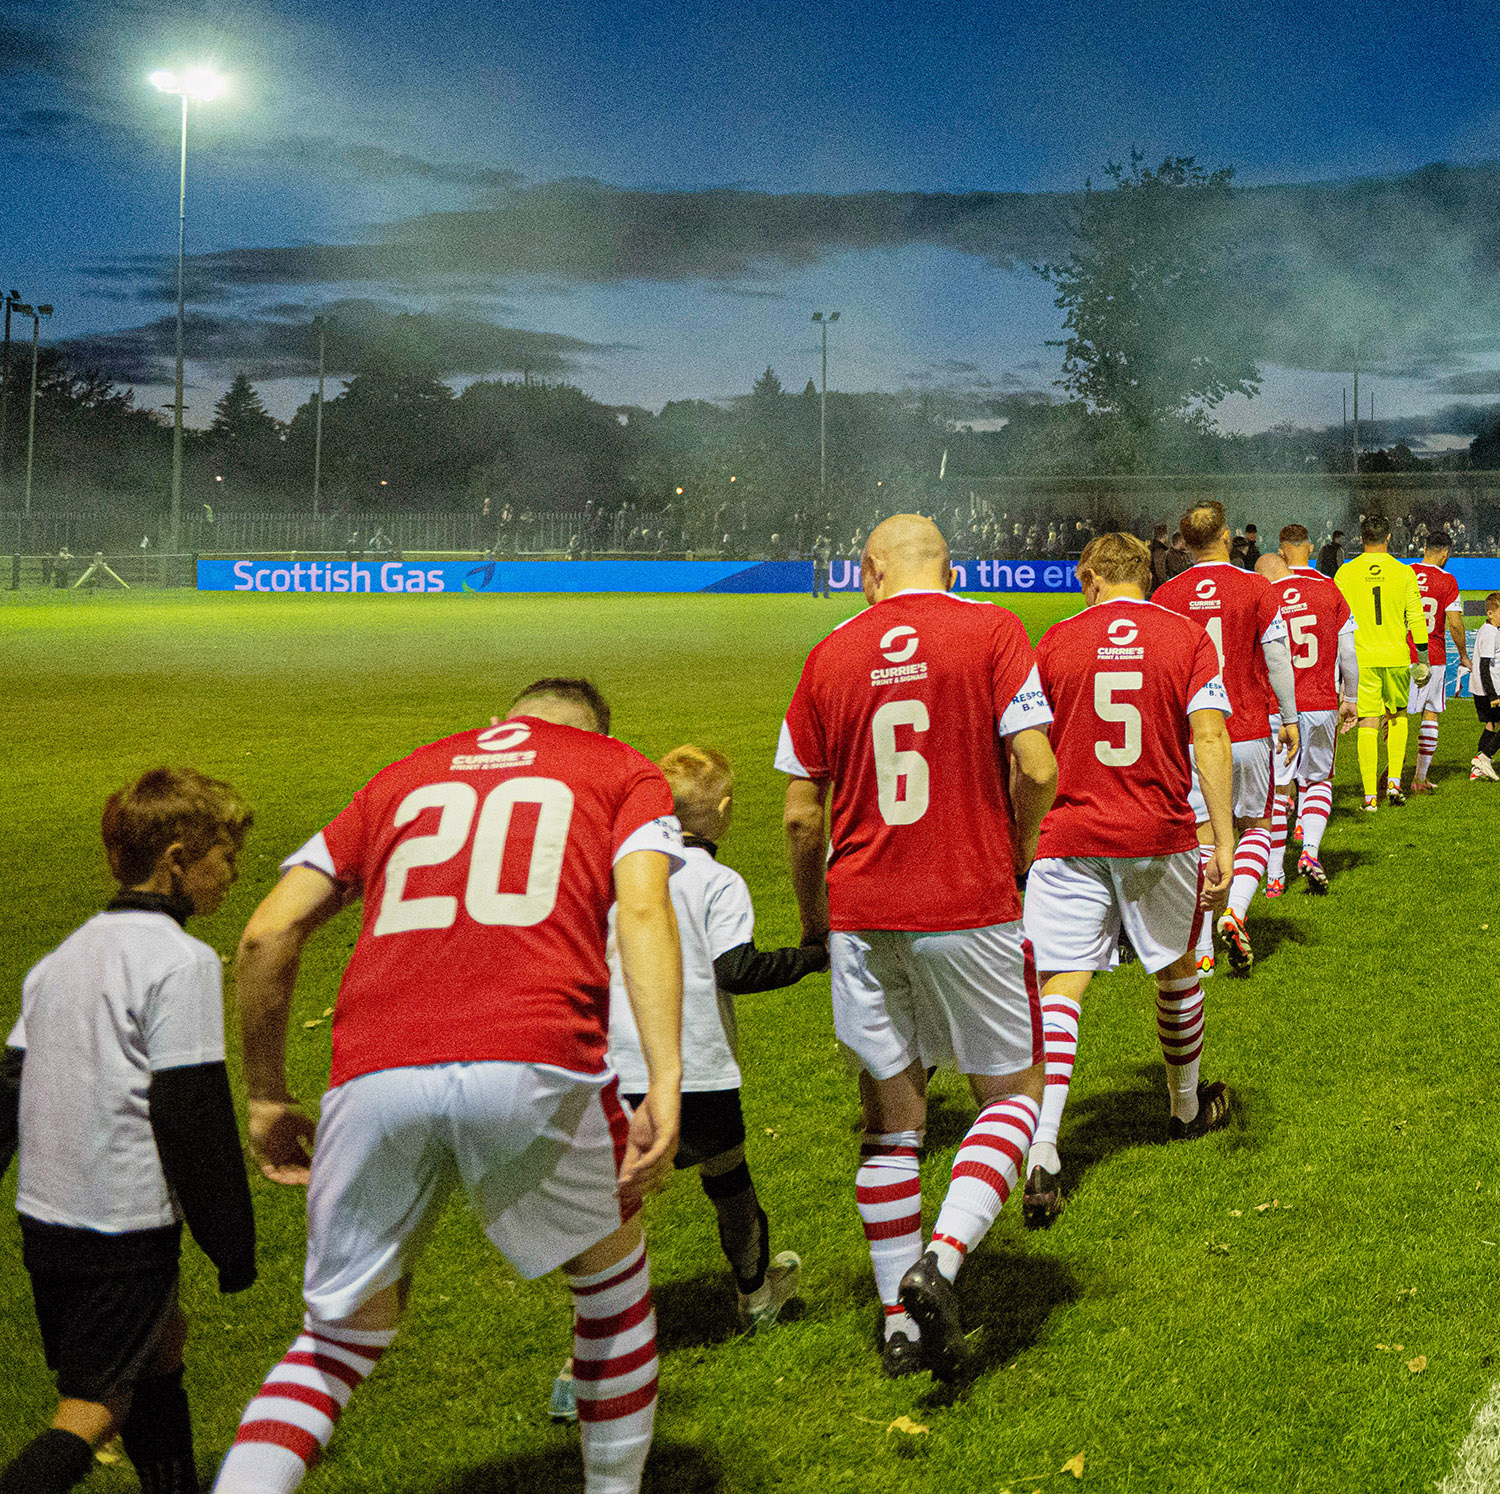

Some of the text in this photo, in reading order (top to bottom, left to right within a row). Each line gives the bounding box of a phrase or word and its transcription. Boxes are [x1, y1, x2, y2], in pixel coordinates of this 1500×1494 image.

[233, 560, 445, 593] Scottish Gas
[977, 560, 1036, 589] the
[1372, 586, 1383, 625] 1
[1097, 647, 1145, 655] CURRIE'S
[870, 662, 928, 680] CURRIE'S
[1094, 671, 1143, 767] 5
[449, 763, 480, 771] PRINT
[451, 749, 537, 765] CURRIE'S
[872, 699, 930, 826] 6
[374, 776, 574, 937] 20
